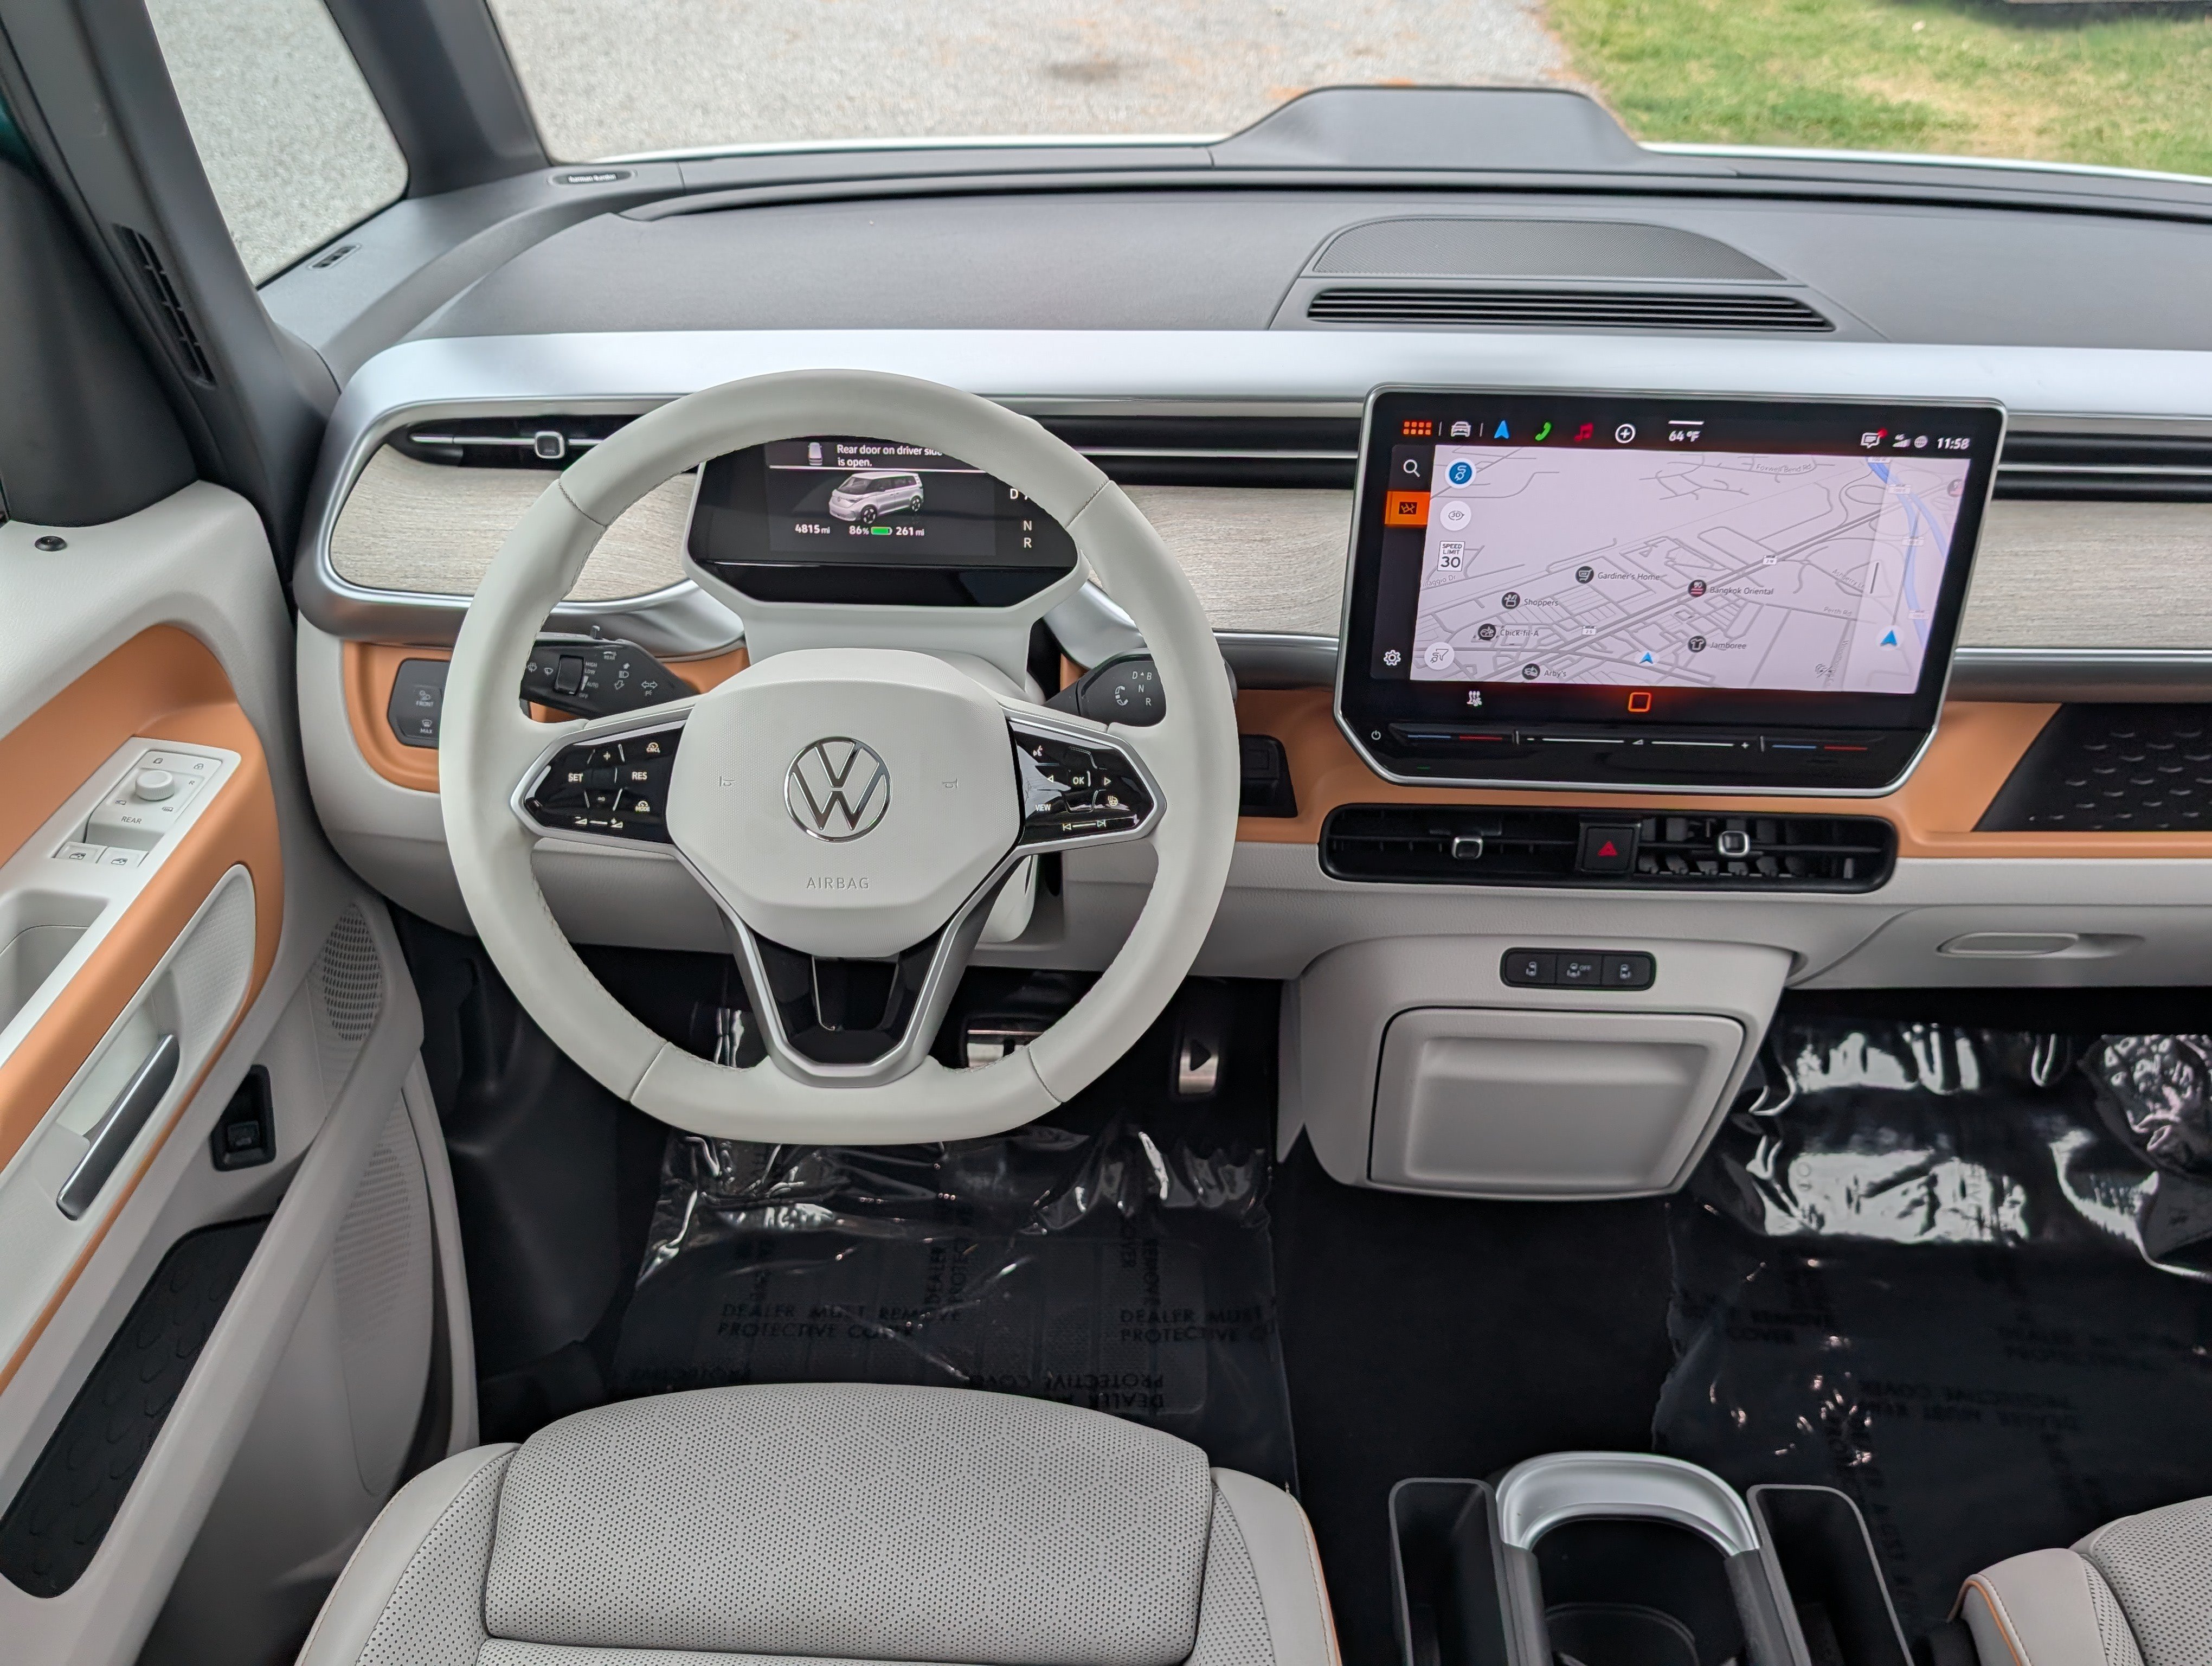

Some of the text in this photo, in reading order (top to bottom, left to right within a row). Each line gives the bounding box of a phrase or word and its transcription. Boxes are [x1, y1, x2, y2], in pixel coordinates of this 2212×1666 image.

[1669, 431, 1684, 442] 64
[1937, 438, 1970, 450] 11:58
[837, 444, 858, 454] Rear
[859, 444, 881, 454] door
[897, 445, 922, 455] driver
[838, 457, 872, 468] is open.
[1009, 488, 1019, 499] D
[795, 524, 820, 534] 4815
[849, 526, 869, 535] 86%
[1023, 520, 1032, 531] N
[895, 526, 914, 536] 261
[1024, 537, 1032, 548] R
[1441, 556, 1461, 568] 30
[1597, 572, 1660, 581] Gardiner's Home
[1422, 577, 1446, 587] illaggio
[1709, 586, 1773, 595] Bangkok Oriental
[1523, 598, 1559, 607] Shoppers
[1500, 629, 1539, 637] Chick-fil-A
[1709, 641, 1747, 650] Jamboree
[1132, 671, 1153, 681] D B
[1544, 669, 1567, 678] Arby's
[1138, 684, 1144, 693] N
[1145, 697, 1152, 706] R
[568, 773, 583, 783] SET
[632, 771, 647, 780] RES
[1073, 777, 1084, 785] OK
[1035, 803, 1051, 811] VIEW
[121, 816, 142, 825] REAR
[806, 877, 870, 890] AIRBAG
[721, 1302, 796, 1318] DEALER
[809, 1304, 866, 1320] MUT
[1120, 1307, 1194, 1324] DEALER
[716, 1322, 837, 1339] PROTECTIVE
[1120, 1326, 1239, 1344] PROTECTIVE
